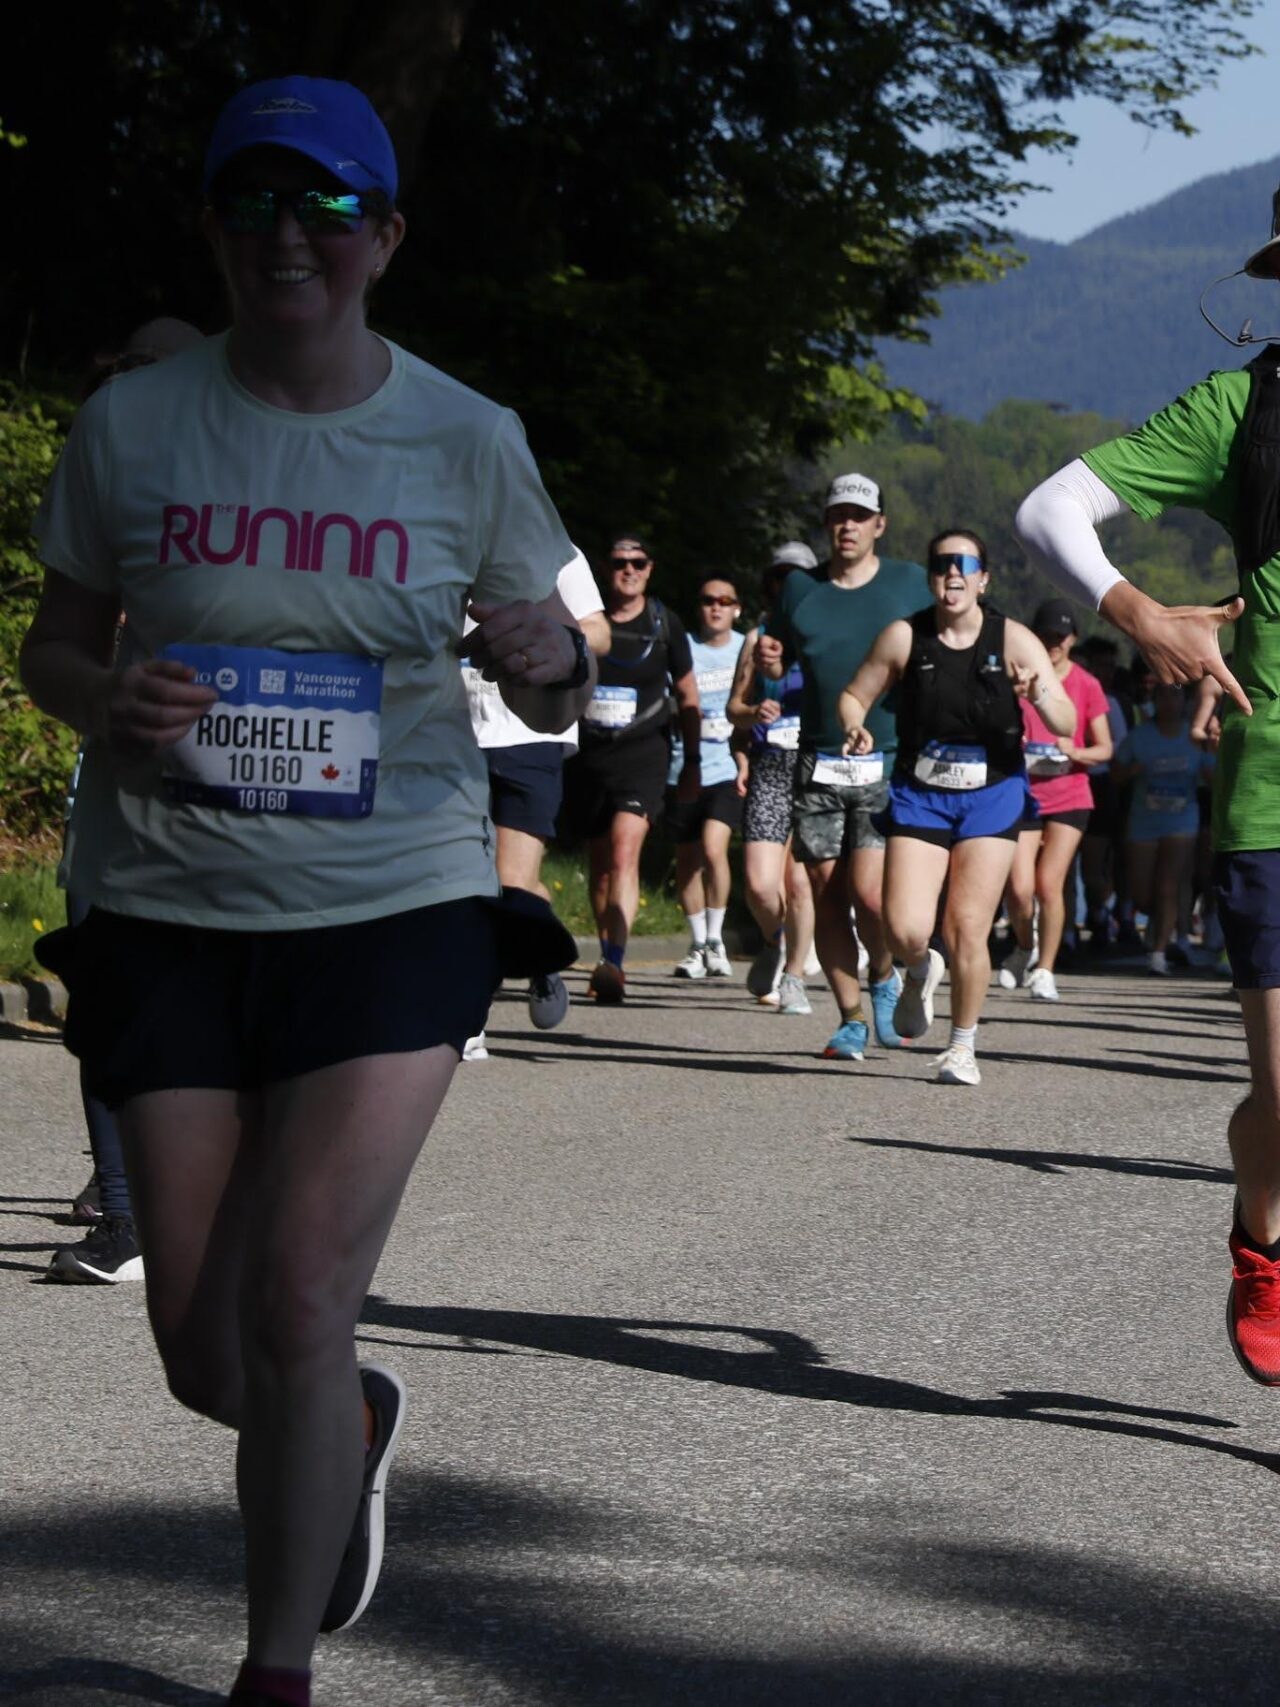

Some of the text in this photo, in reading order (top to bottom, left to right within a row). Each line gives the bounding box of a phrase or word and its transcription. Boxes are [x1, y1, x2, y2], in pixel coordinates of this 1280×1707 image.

[830, 481, 872, 497] ciele
[294, 671, 361, 686] Vancouver
[294, 684, 356, 698] Marathon
[196, 714, 334, 753] ROCHELLE
[228, 753, 303, 785] 10160
[239, 789, 289, 811] 10160
